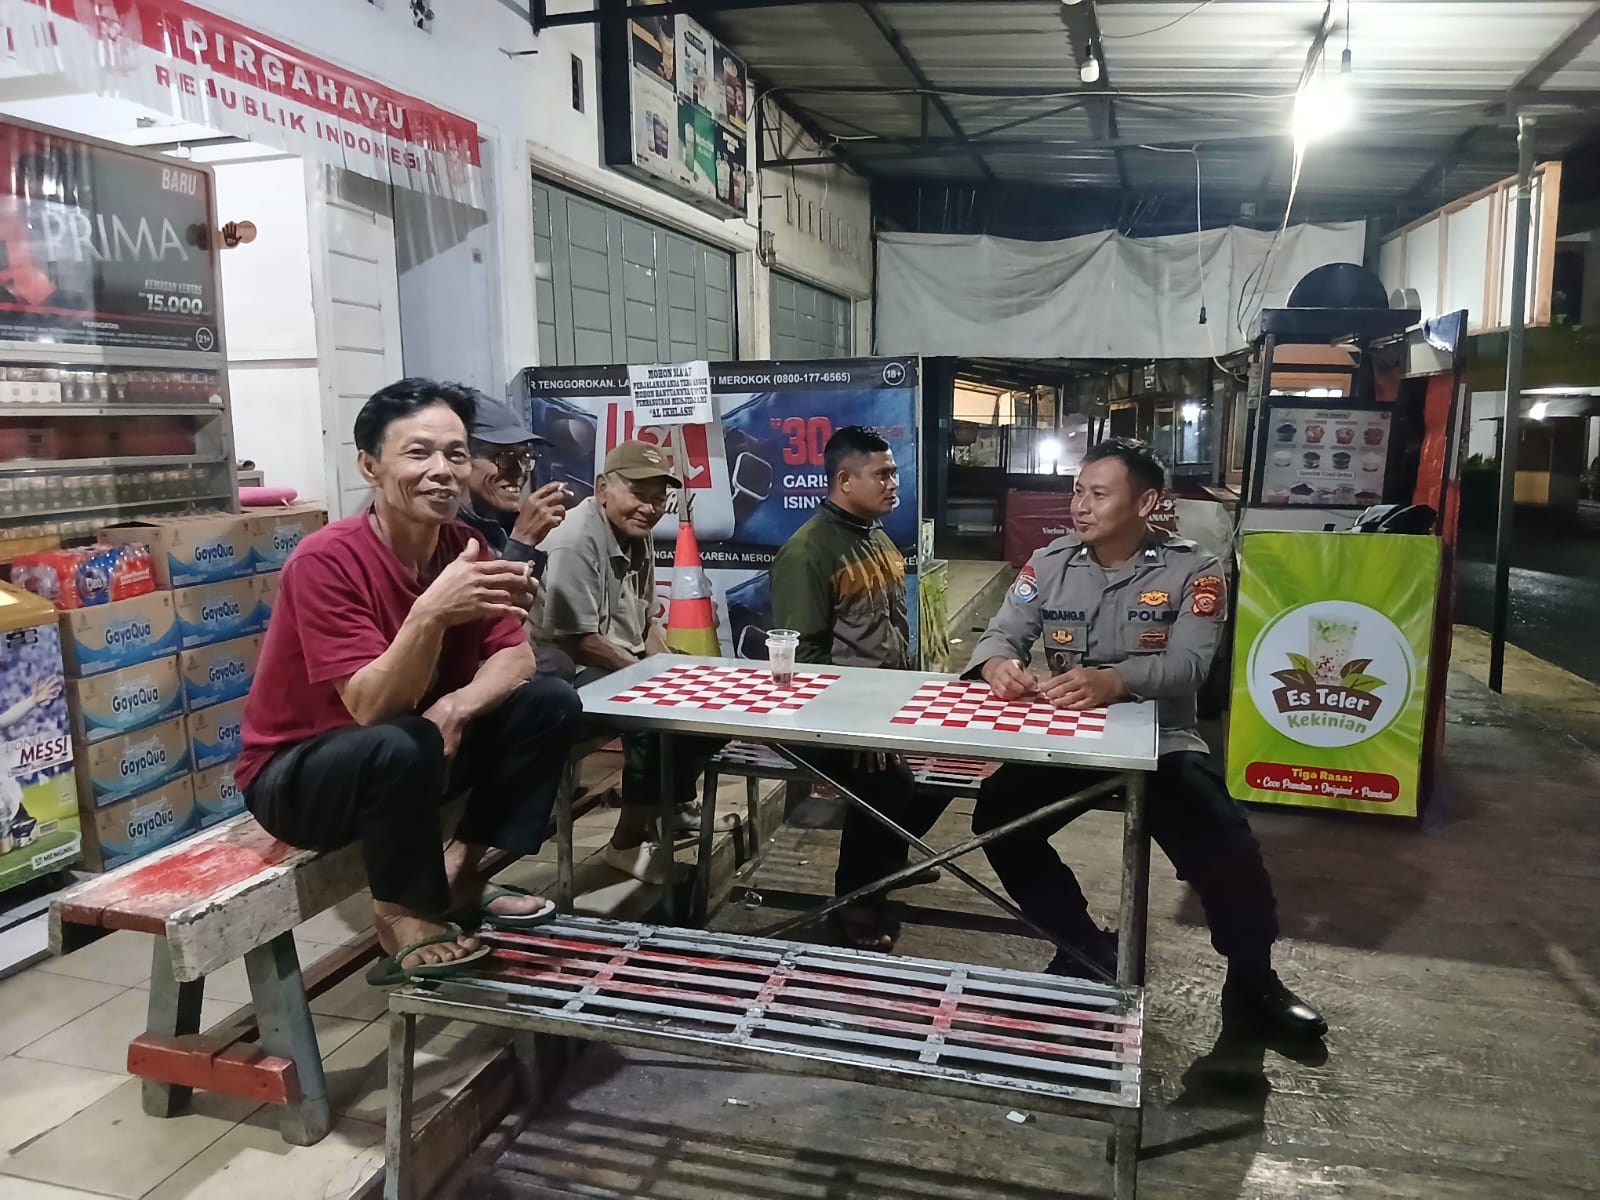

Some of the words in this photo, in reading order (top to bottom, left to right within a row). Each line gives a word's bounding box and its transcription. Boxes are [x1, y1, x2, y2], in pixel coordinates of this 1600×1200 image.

[182, 19, 405, 131] DIRGAHAYU
[162, 168, 197, 195] BARU
[41, 209, 190, 262] PRIMA
[146, 293, 203, 315] 15.000
[539, 379, 617, 390] TENGGOROKAN.
[719, 374, 771, 385] MEROKOK
[773, 371, 851, 386] (0800-177-6565)
[195, 543, 234, 564] GayaQua
[699, 551, 739, 561] KARENA
[201, 601, 240, 623] GayaQua
[105, 622, 151, 646] GayaQua
[208, 661, 246, 684] GayaQua
[112, 688, 159, 714] GayaQua
[1286, 689, 1311, 707] Es
[1316, 688, 1371, 712] Teler
[1287, 714, 1367, 735] Kekinian
[20, 735, 68, 765] MESSI
[120, 747, 167, 777] GayaQua
[1291, 768, 1318, 782] Tiga
[1319, 770, 1353, 783] Rasa:
[128, 811, 174, 840] GayaQua
